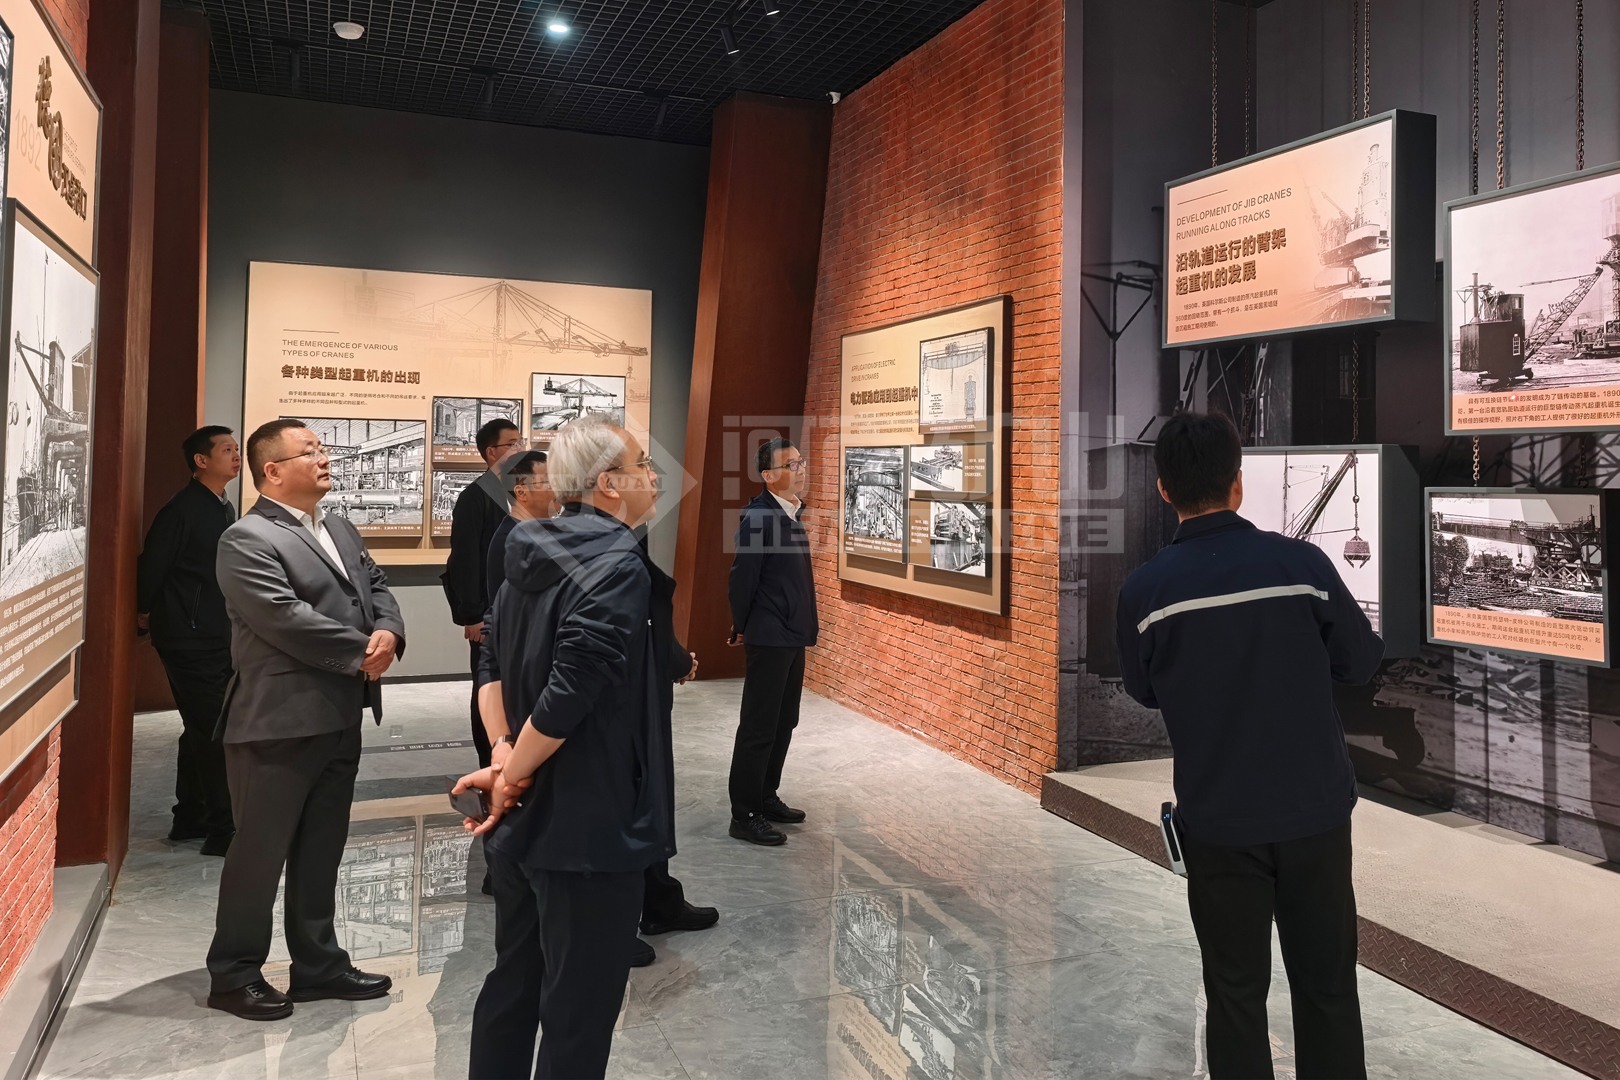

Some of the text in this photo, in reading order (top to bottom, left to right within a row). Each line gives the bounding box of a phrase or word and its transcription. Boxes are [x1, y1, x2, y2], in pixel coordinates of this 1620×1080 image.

[15, 108, 41, 172] 1892
[1177, 187, 1292, 227] DEVELOPMENT OF JIB CRANES
[1176, 209, 1271, 241] RUNNING ALONG TRACKS
[1176, 227, 1287, 272] 沿轨道运行的臂架
[1175, 259, 1257, 296] 起重机的发展
[282, 339, 399, 351] THE EMERGENCE OF VARIOUS
[282, 349, 309, 357] TYPES
[321, 351, 355, 359] CRANES
[281, 364, 421, 385] 各种类型起重机的出现
[851, 362, 873, 372] APPLICATION
[878, 358, 896, 368] ELECTRIC
[865, 372, 879, 380] CRANES
[850, 385, 919, 405] 电力驱动应用到起重机中
